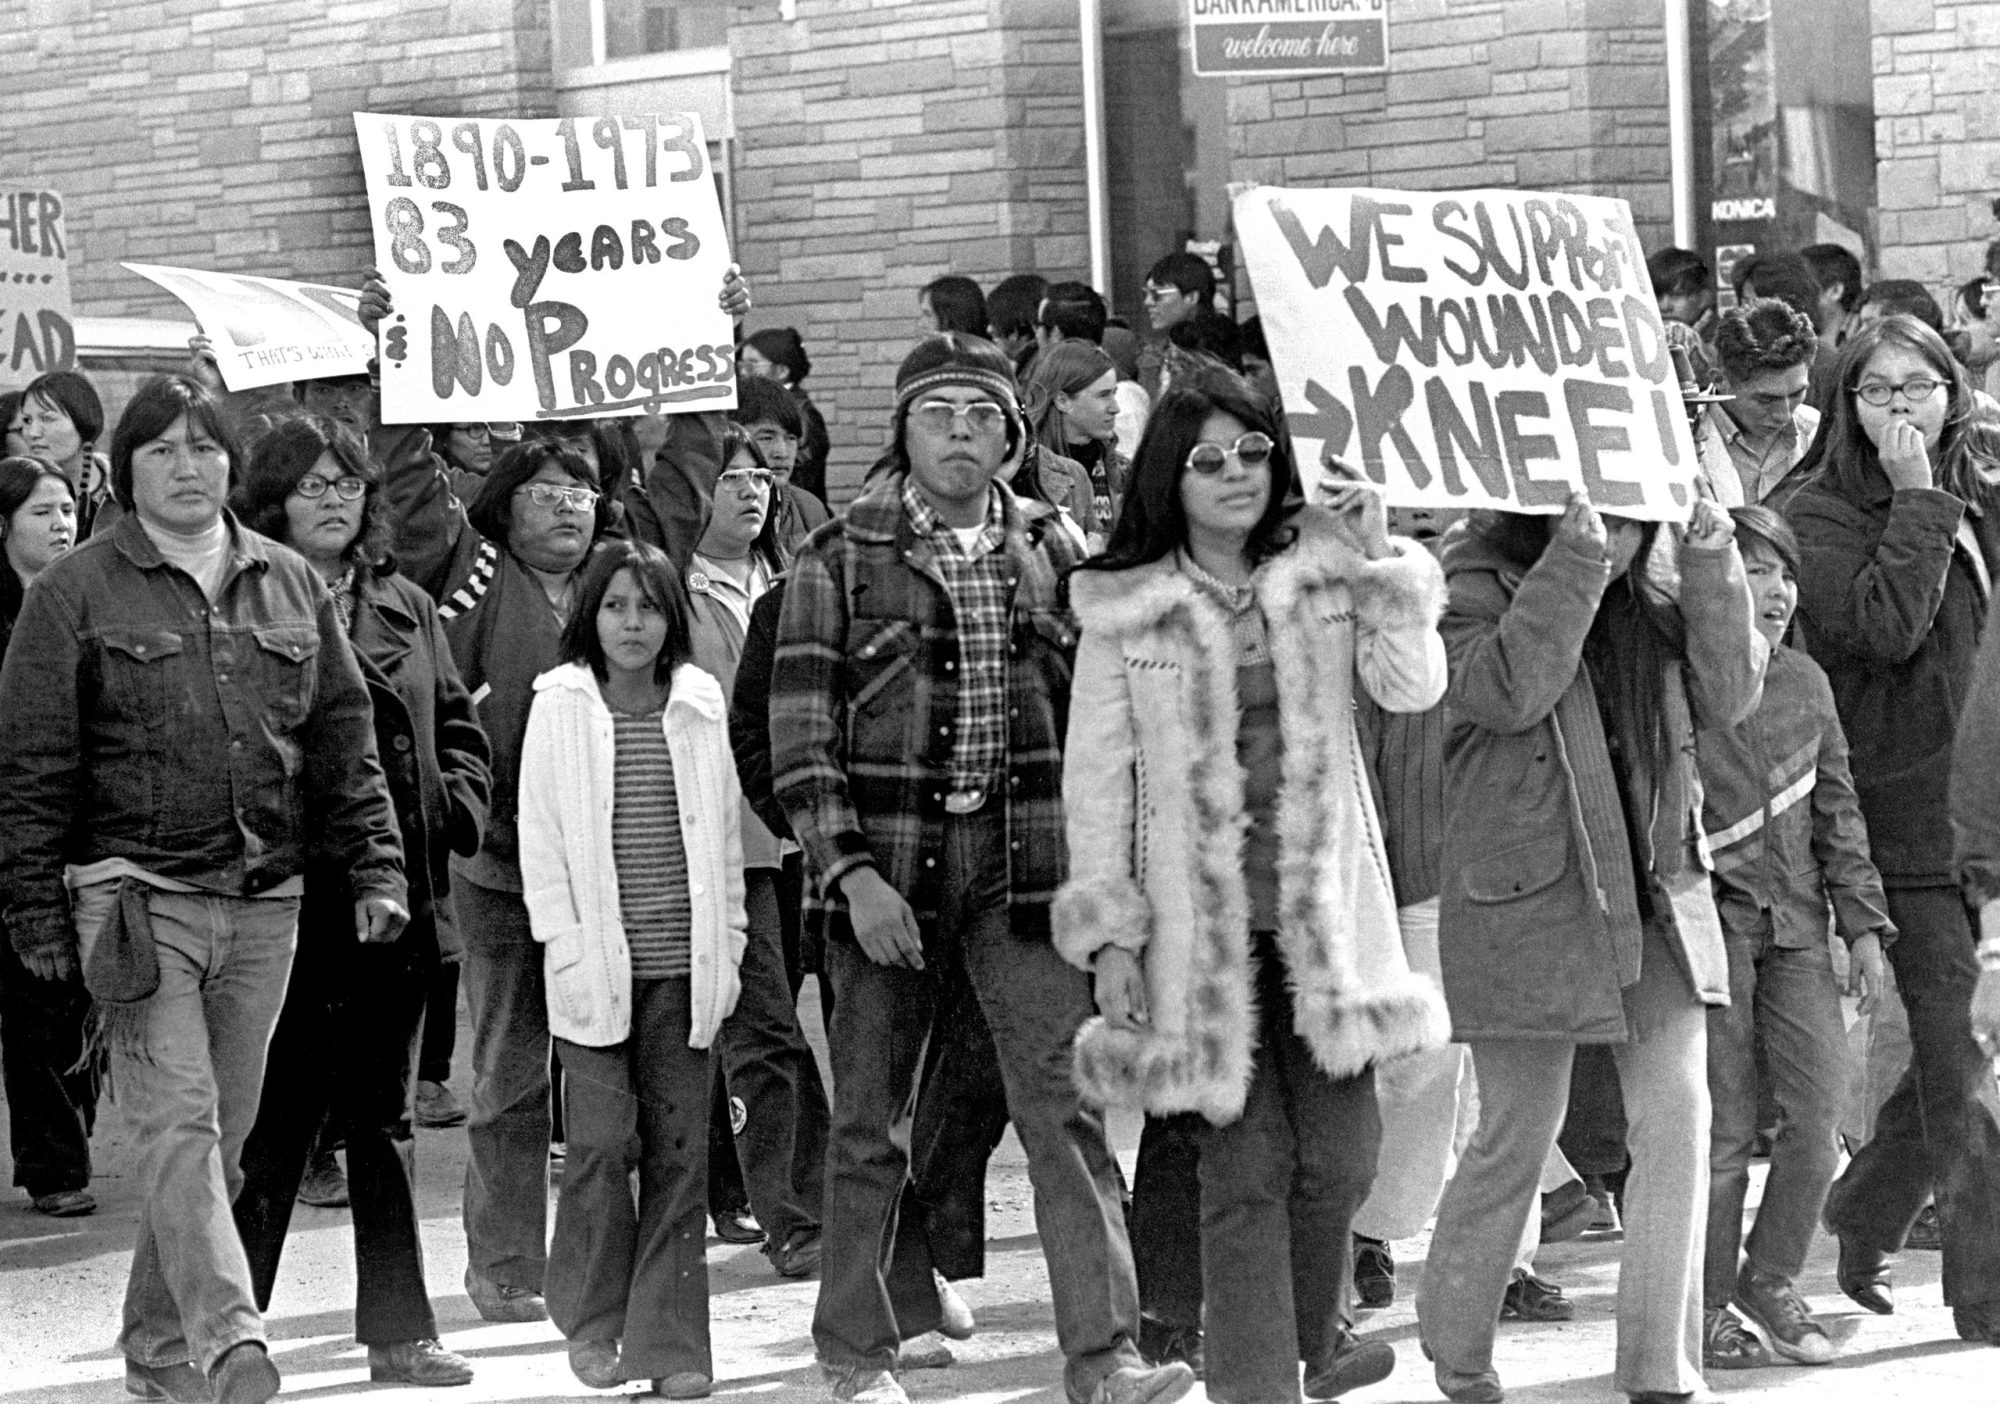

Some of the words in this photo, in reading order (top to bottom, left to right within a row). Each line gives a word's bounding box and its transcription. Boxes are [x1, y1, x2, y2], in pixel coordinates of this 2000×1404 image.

[1223, 24, 1312, 58] welcome
[1316, 22, 1358, 57] here
[382, 113, 703, 192] 1890-1973
[385, 197, 477, 274] 83
[1268, 194, 1428, 289] WE
[1711, 198, 1776, 219] KONICA
[431, 304, 514, 399] NO
[1343, 284, 1668, 384] WOUNDED
[1348, 363, 1688, 506] KNEE!
